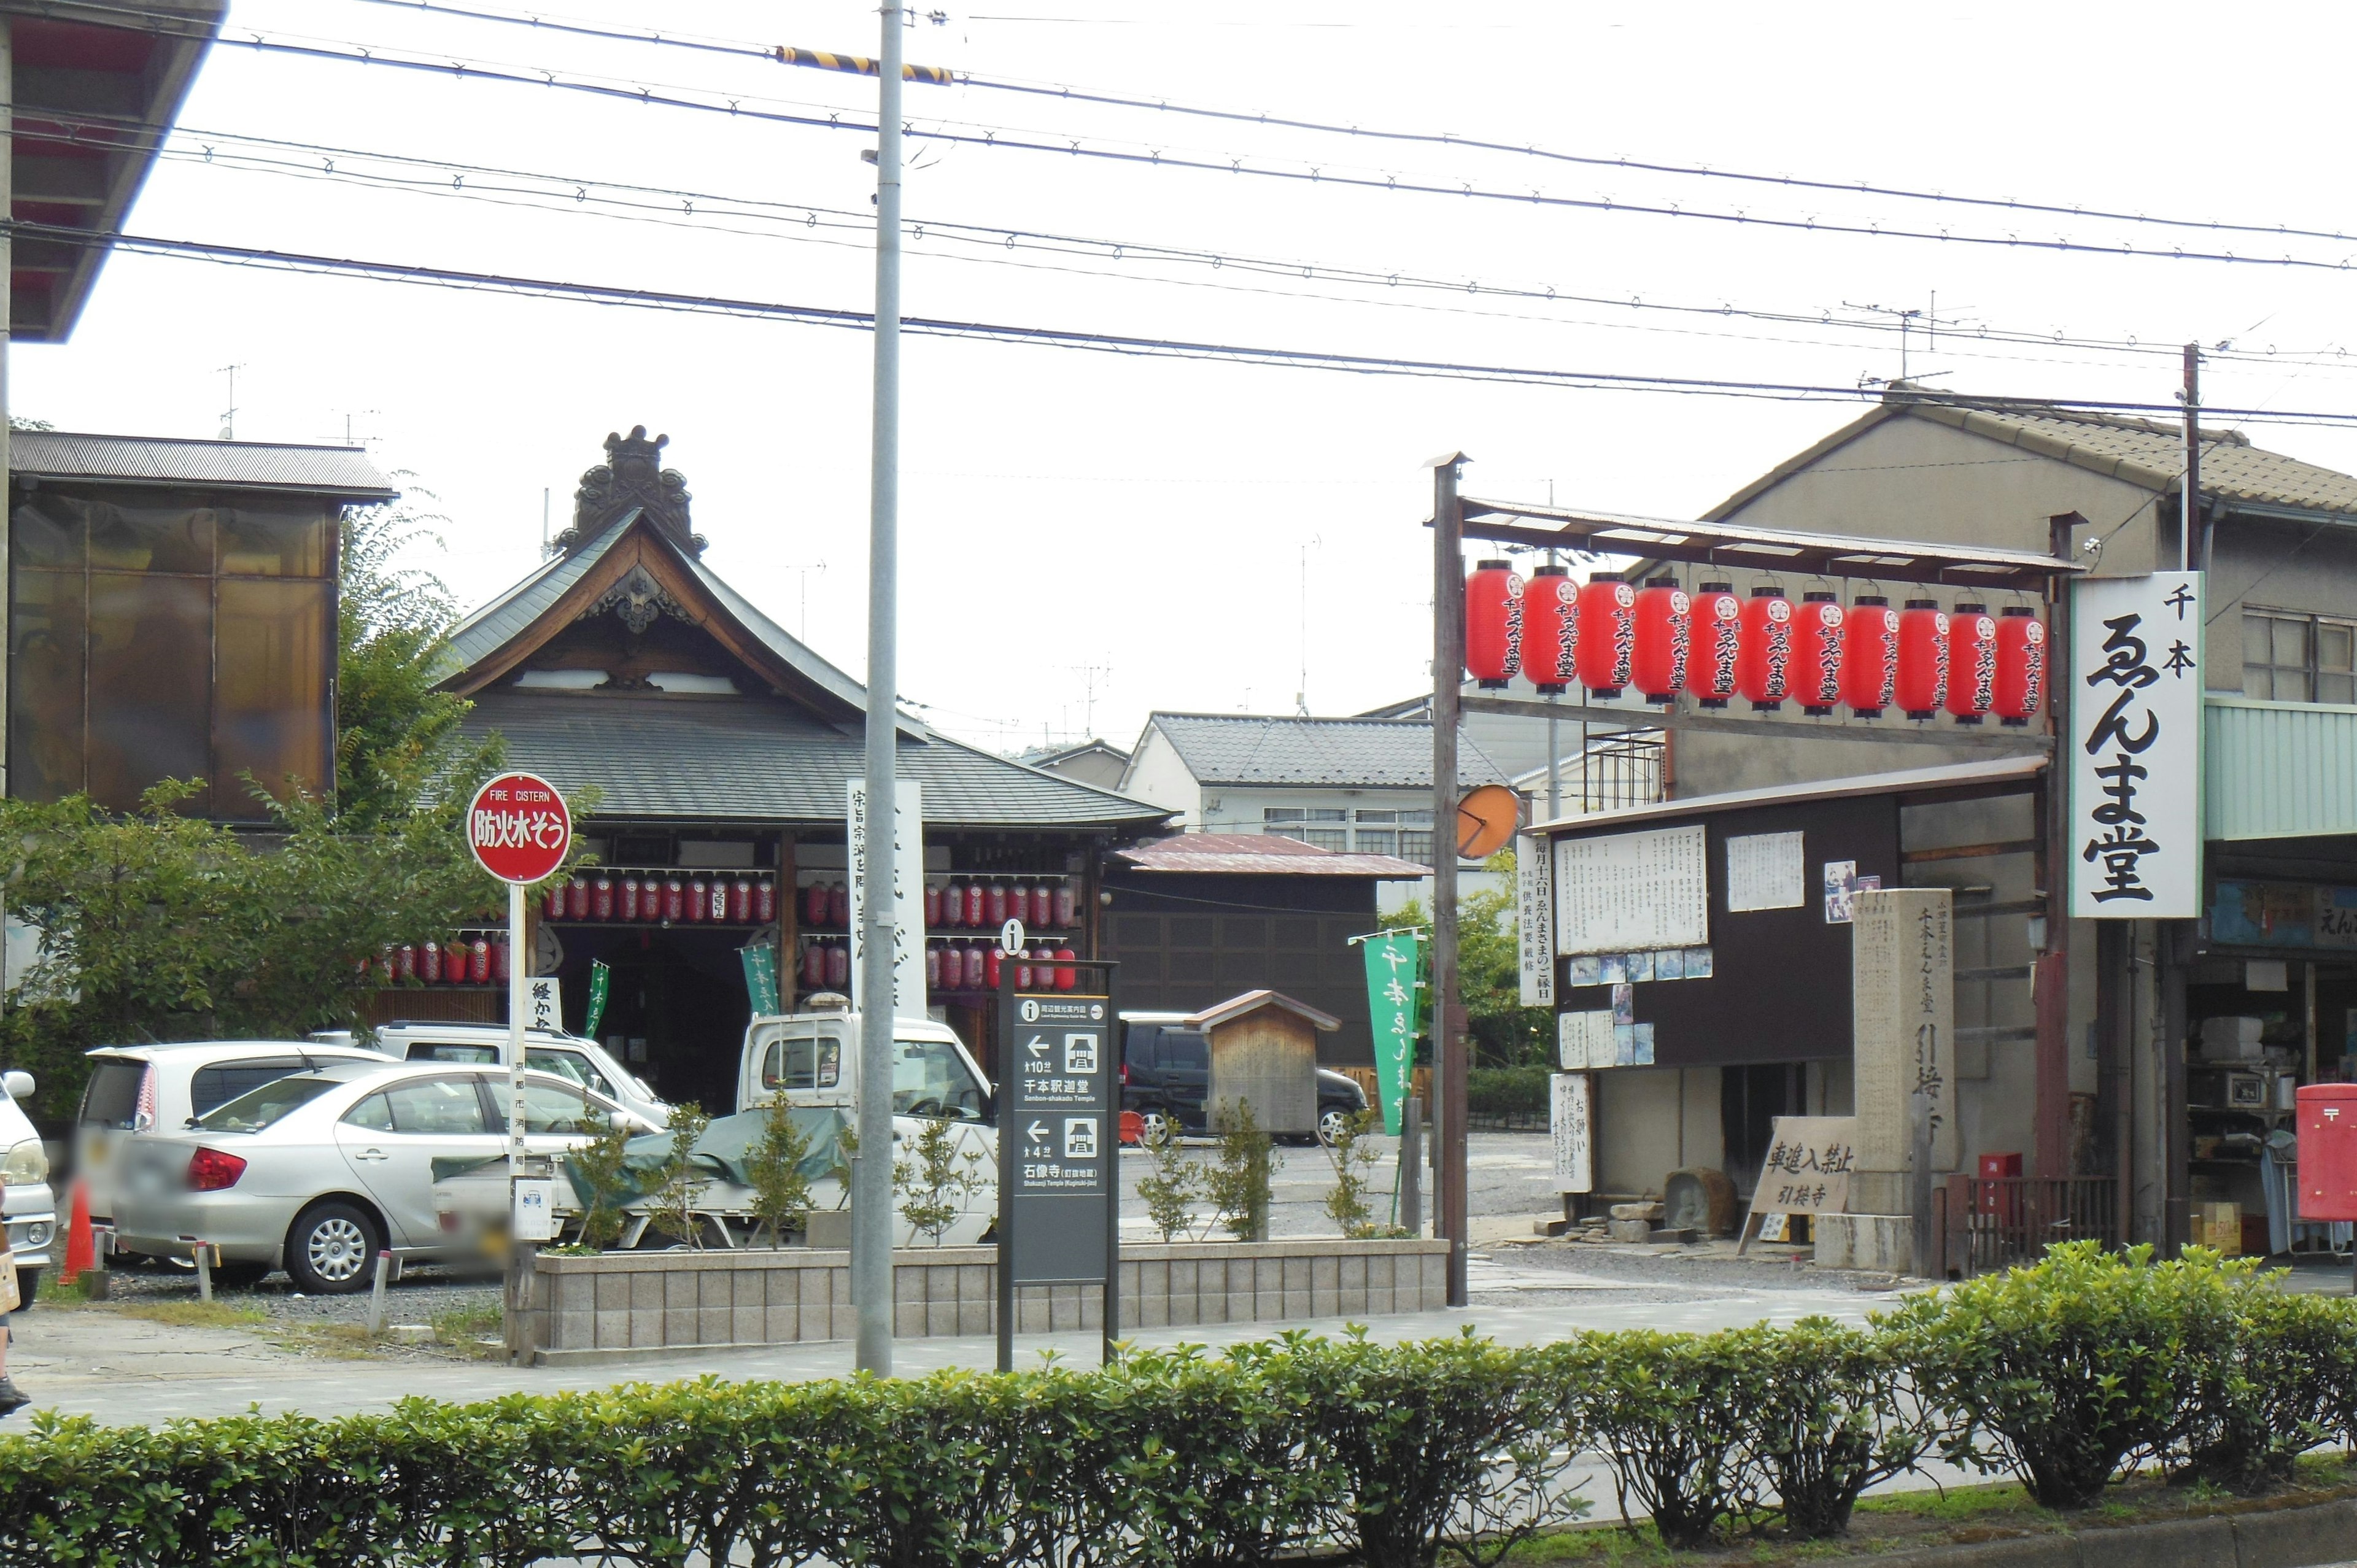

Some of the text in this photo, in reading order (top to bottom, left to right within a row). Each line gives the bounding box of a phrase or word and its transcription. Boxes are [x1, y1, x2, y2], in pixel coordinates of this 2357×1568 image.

[2162, 583, 2196, 679] 千本
[2083, 612, 2160, 903] ゑんま堂
[490, 790, 549, 802] FIRE CISTERN
[474, 809, 565, 849] 防火水そう
[1024, 1079, 1088, 1093] 千本釈迦堂
[514, 1061, 524, 1165] 京都市消防局
[1767, 1141, 1854, 1175] 車進入禁止
[1778, 1184, 1826, 1207] 引接寺
